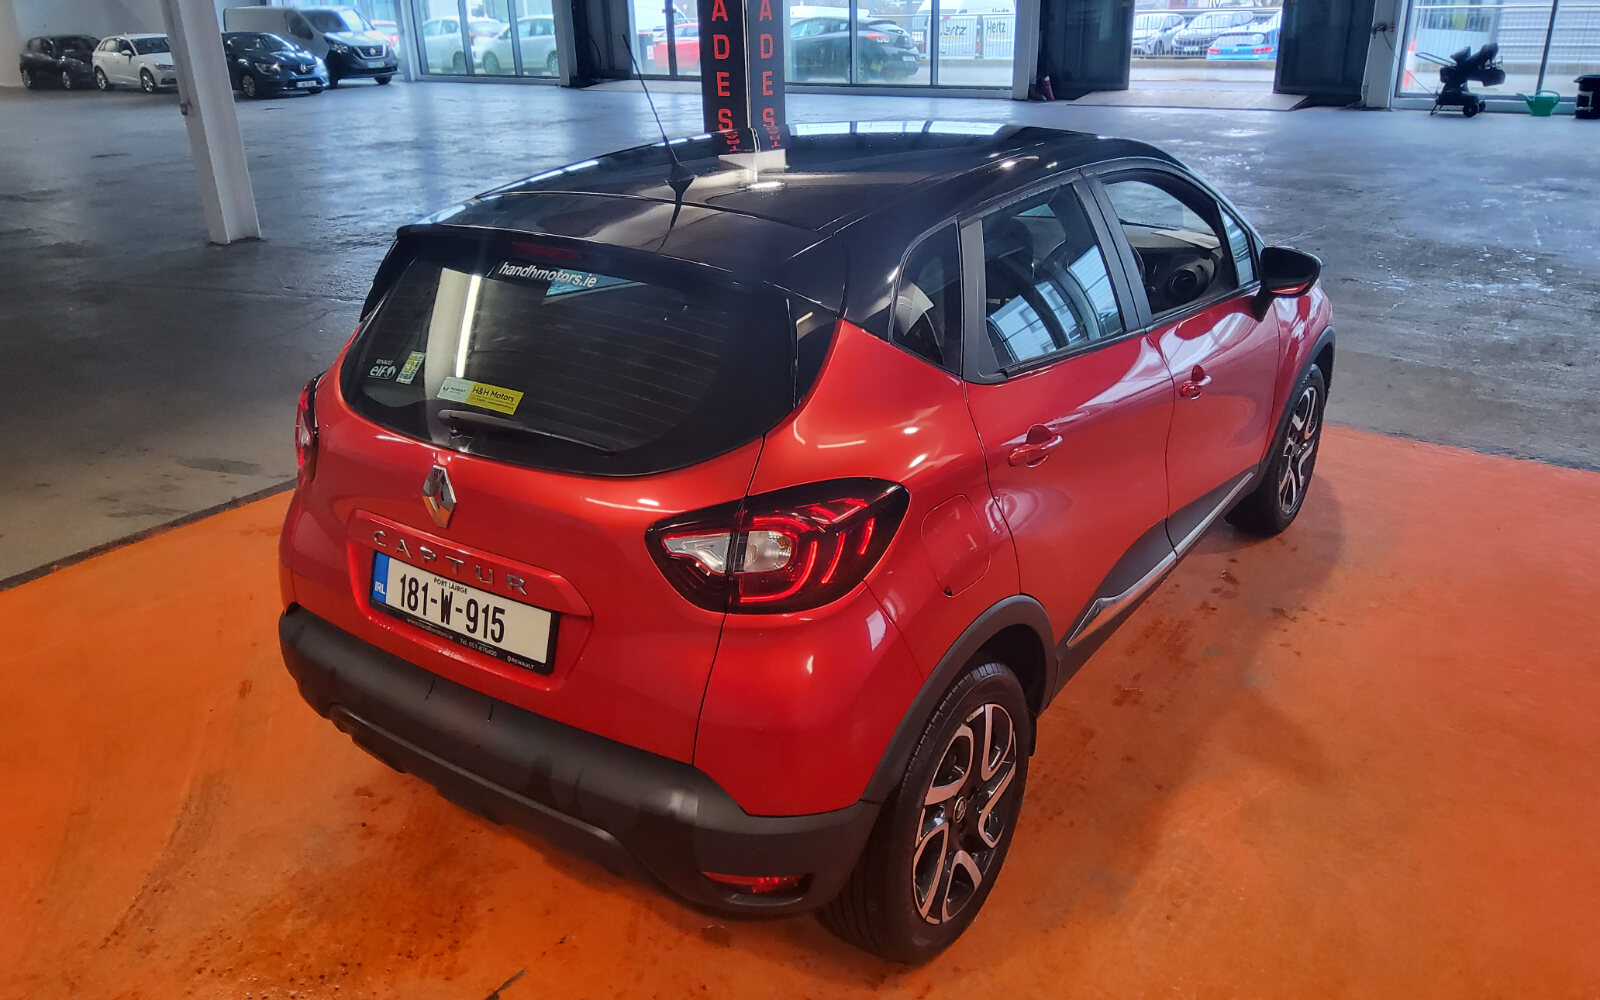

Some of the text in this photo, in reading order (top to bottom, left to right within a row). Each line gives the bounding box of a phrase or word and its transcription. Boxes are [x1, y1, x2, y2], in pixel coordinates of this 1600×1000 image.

[940, 24, 967, 36] ertz
[986, 20, 1006, 34] Hertz
[498, 261, 598, 288] handhmotors.ie
[472, 386, 515, 403] H&H Motors
[373, 530, 527, 596] CAPTUR
[374, 581, 386, 595] IRL
[434, 577, 448, 588] PORT
[400, 574, 505, 643] 181-W-915
